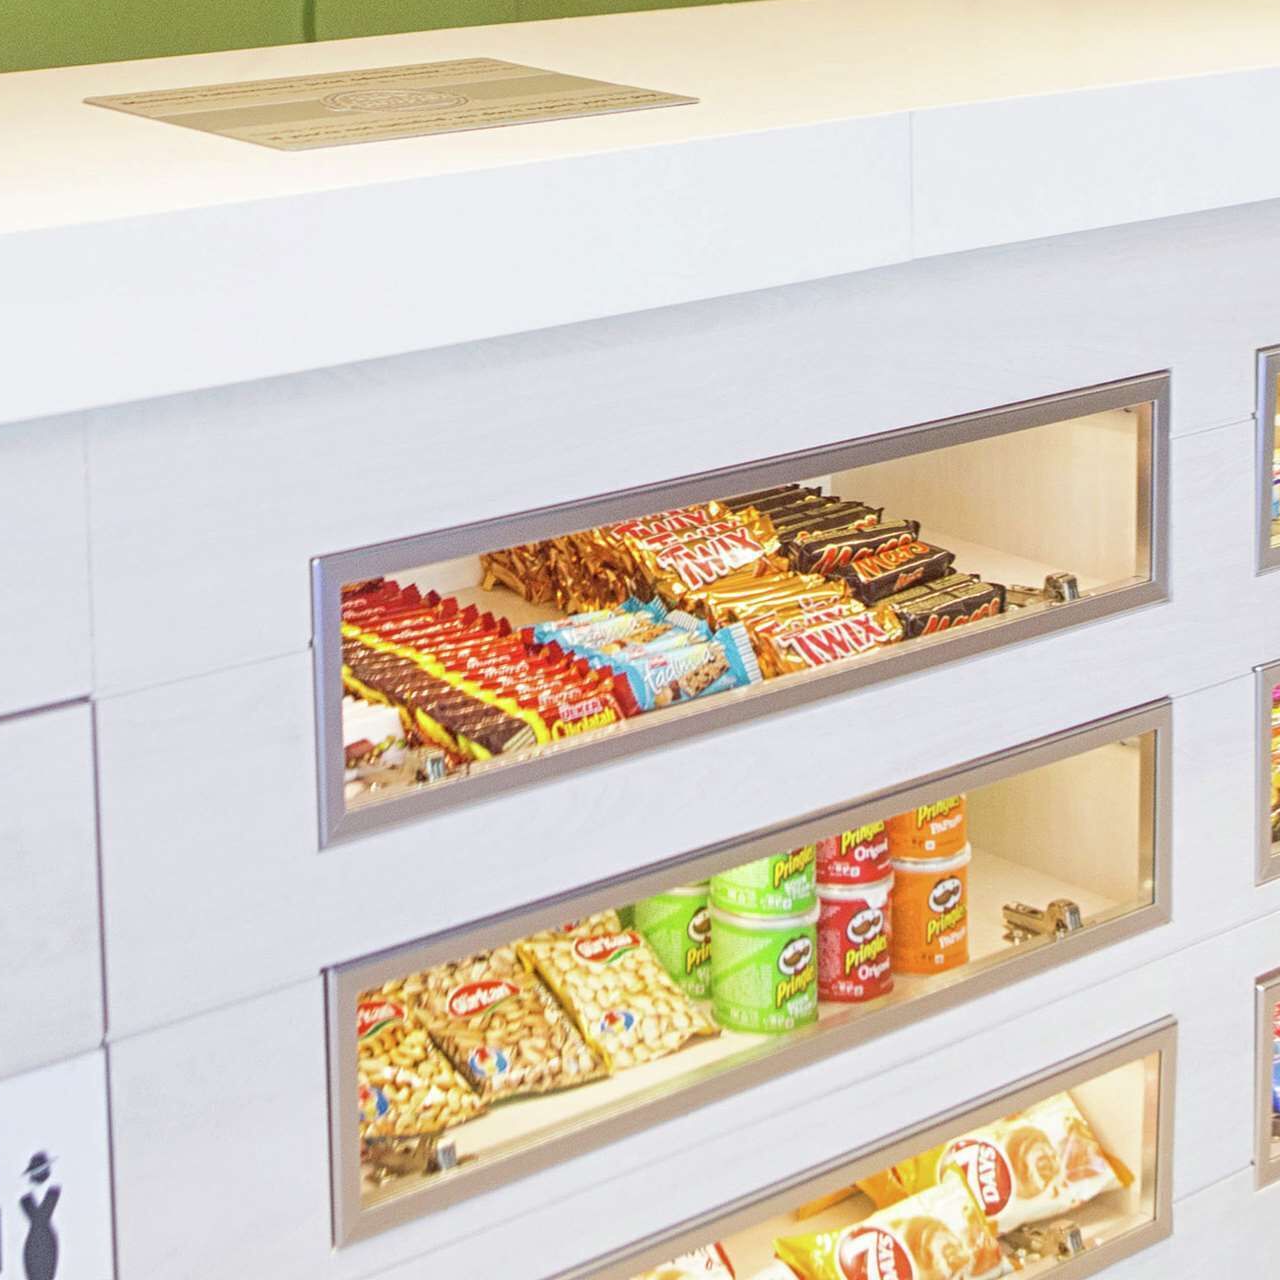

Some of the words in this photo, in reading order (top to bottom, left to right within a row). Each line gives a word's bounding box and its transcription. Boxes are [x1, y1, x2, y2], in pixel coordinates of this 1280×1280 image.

[656, 527, 765, 591] TWIX
[774, 612, 889, 668] TWIX
[977, 1144, 1002, 1203] DAYS
